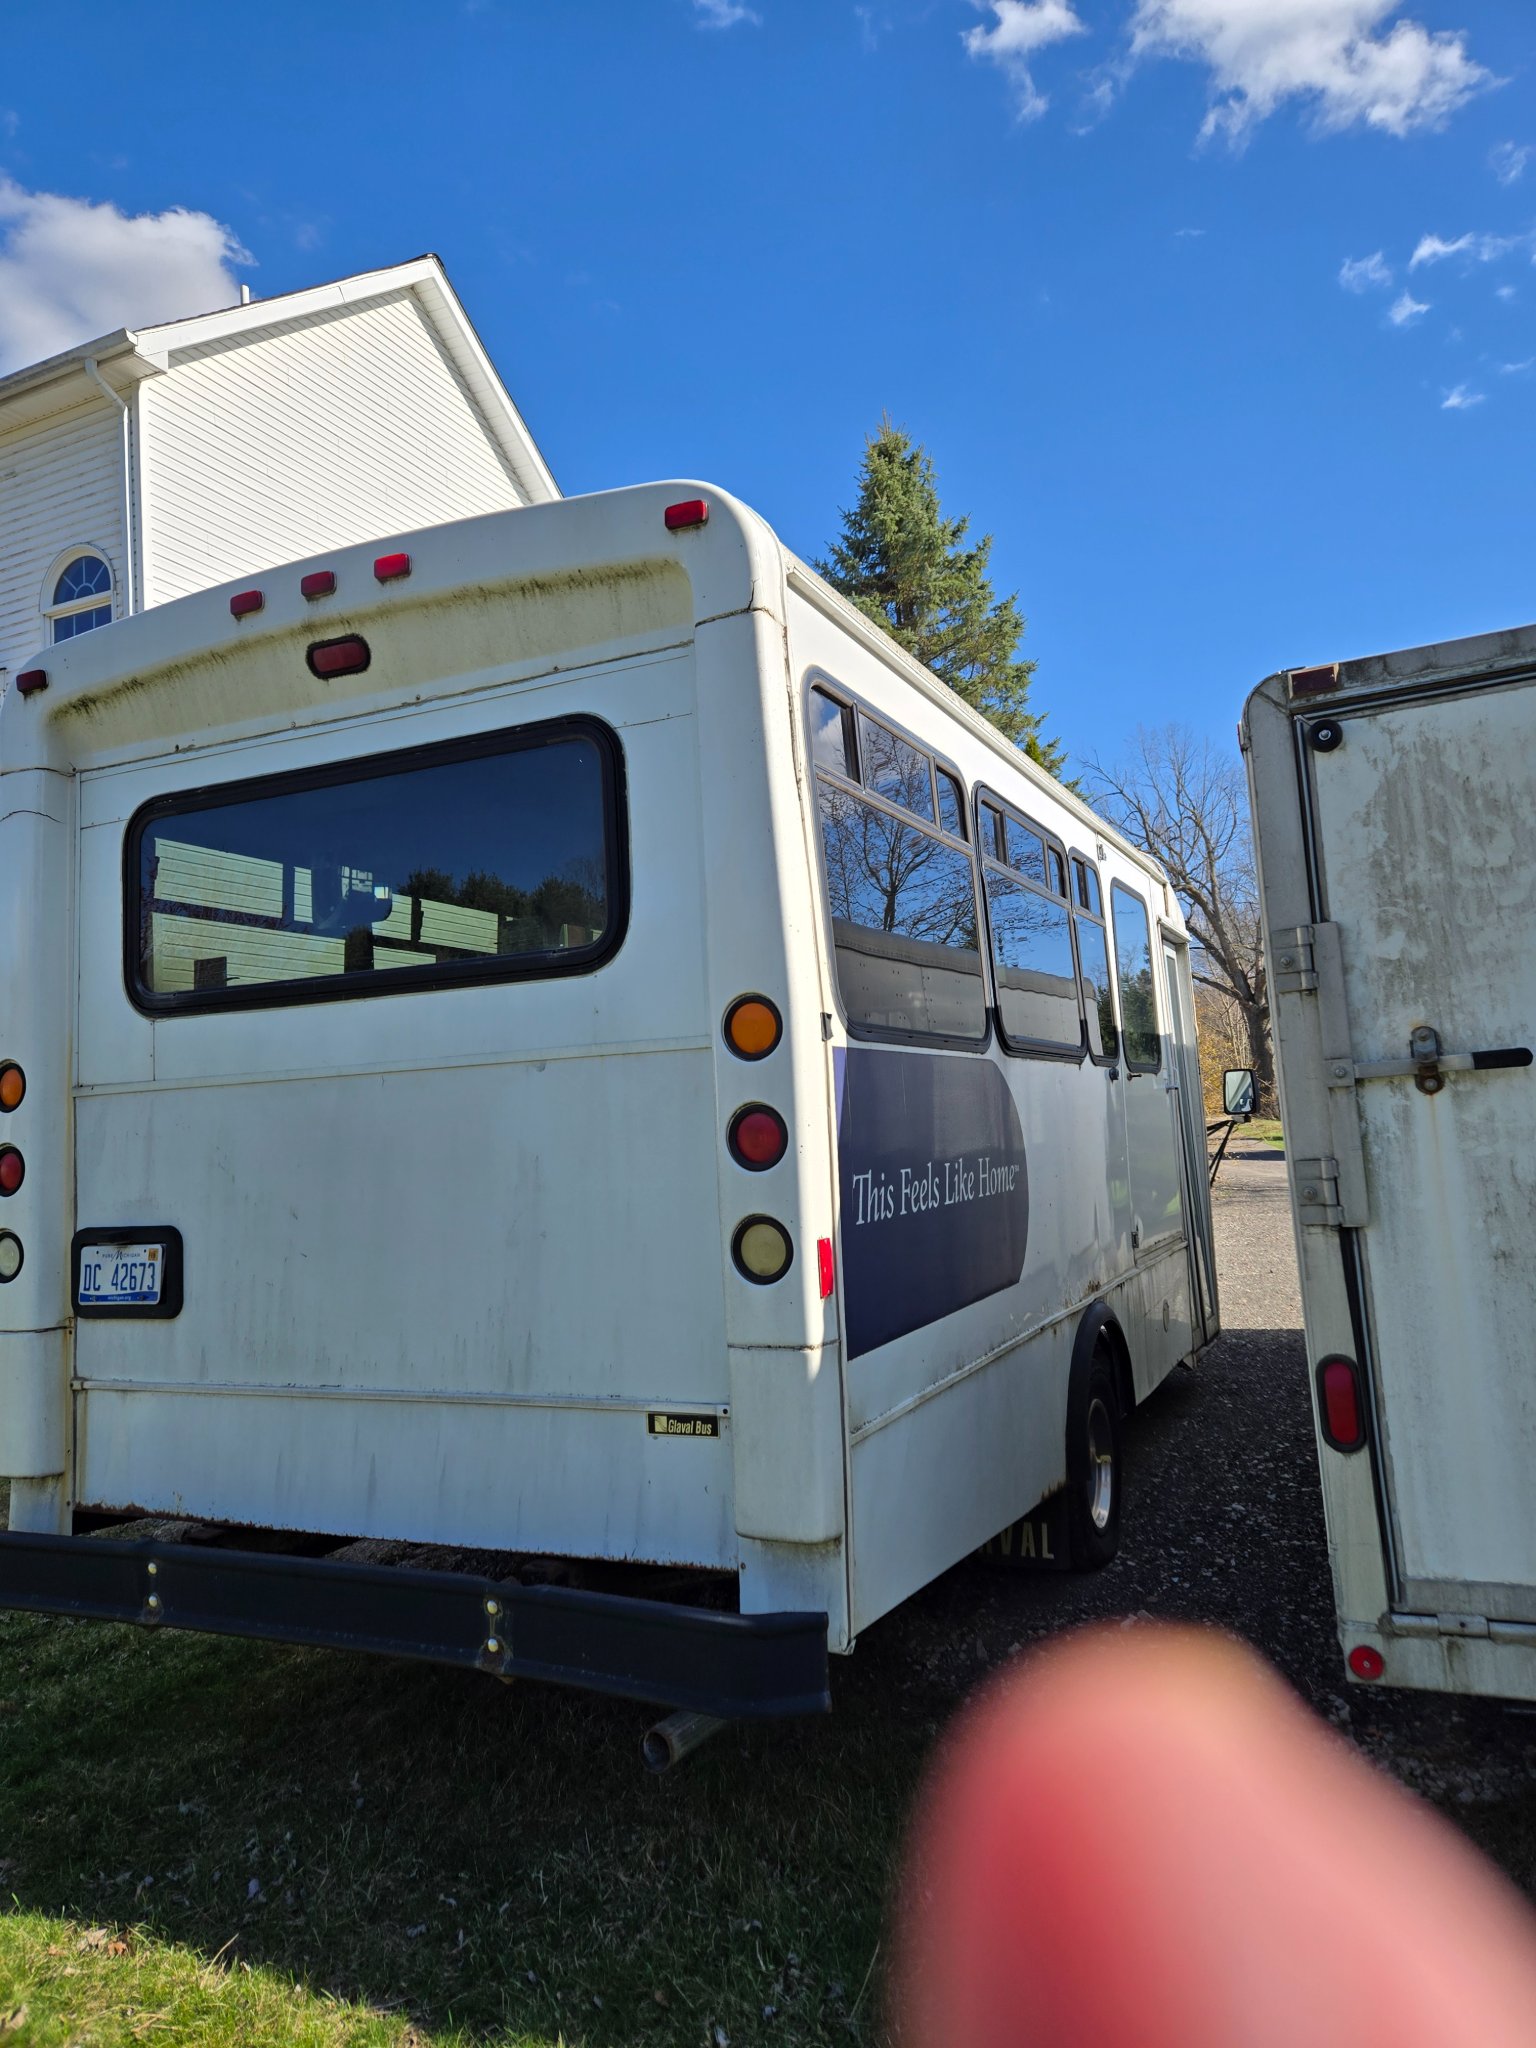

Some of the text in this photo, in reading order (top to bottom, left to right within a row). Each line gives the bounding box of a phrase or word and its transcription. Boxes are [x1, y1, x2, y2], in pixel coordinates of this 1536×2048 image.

[852, 1169, 894, 1226] This
[900, 1161, 940, 1216] Feels
[944, 1157, 975, 1205] Like
[83, 1262, 156, 1292] DC 42673
[668, 1419, 712, 1435] Glaval Bus
